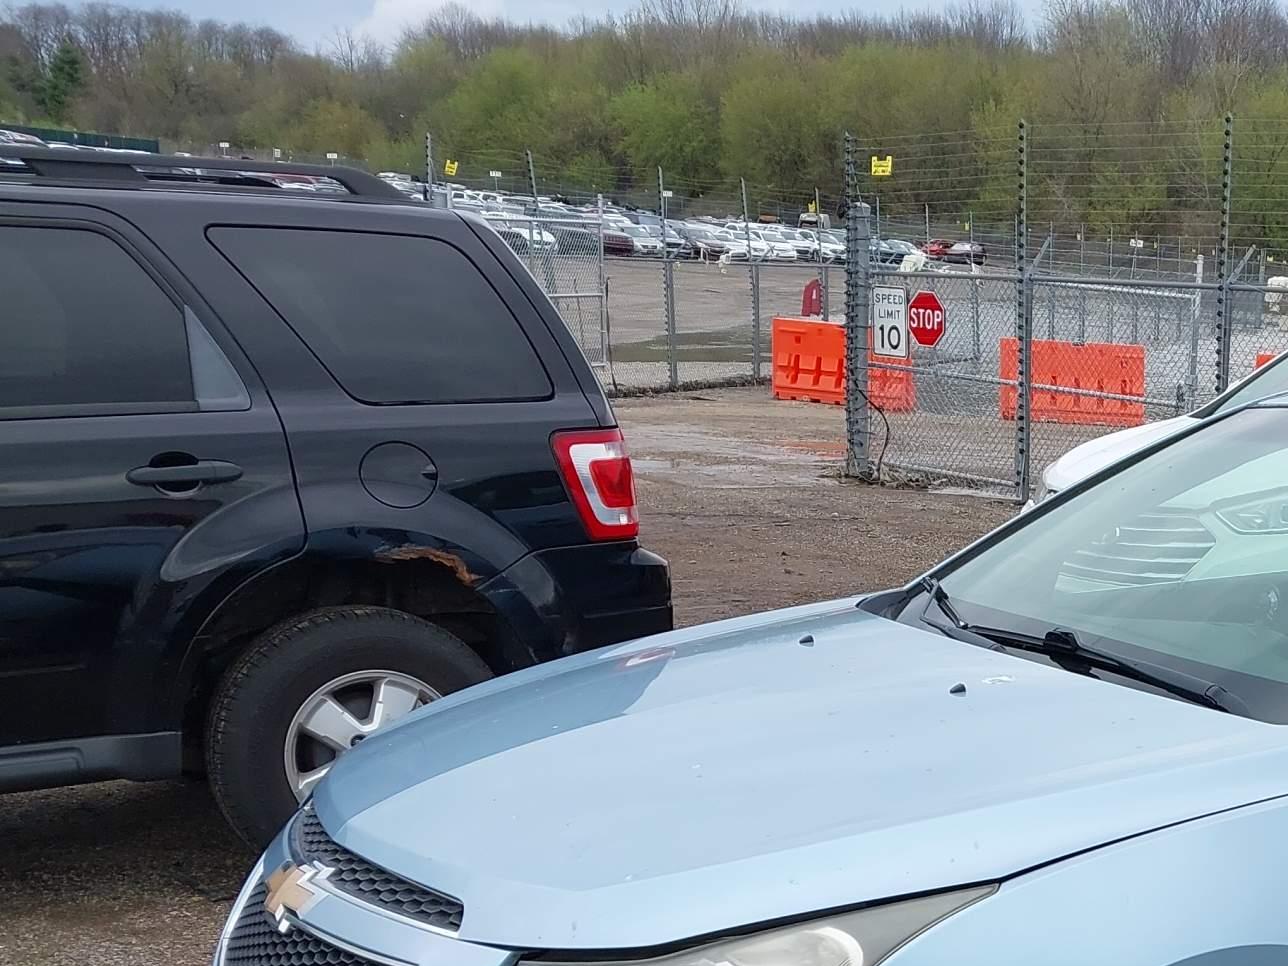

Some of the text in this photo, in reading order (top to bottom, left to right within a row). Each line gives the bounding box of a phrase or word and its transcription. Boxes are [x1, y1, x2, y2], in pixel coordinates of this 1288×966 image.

[875, 293, 903, 305] SPEED
[878, 309, 901, 320] LIMIT
[910, 307, 942, 330] STOP
[879, 324, 901, 350] 10
